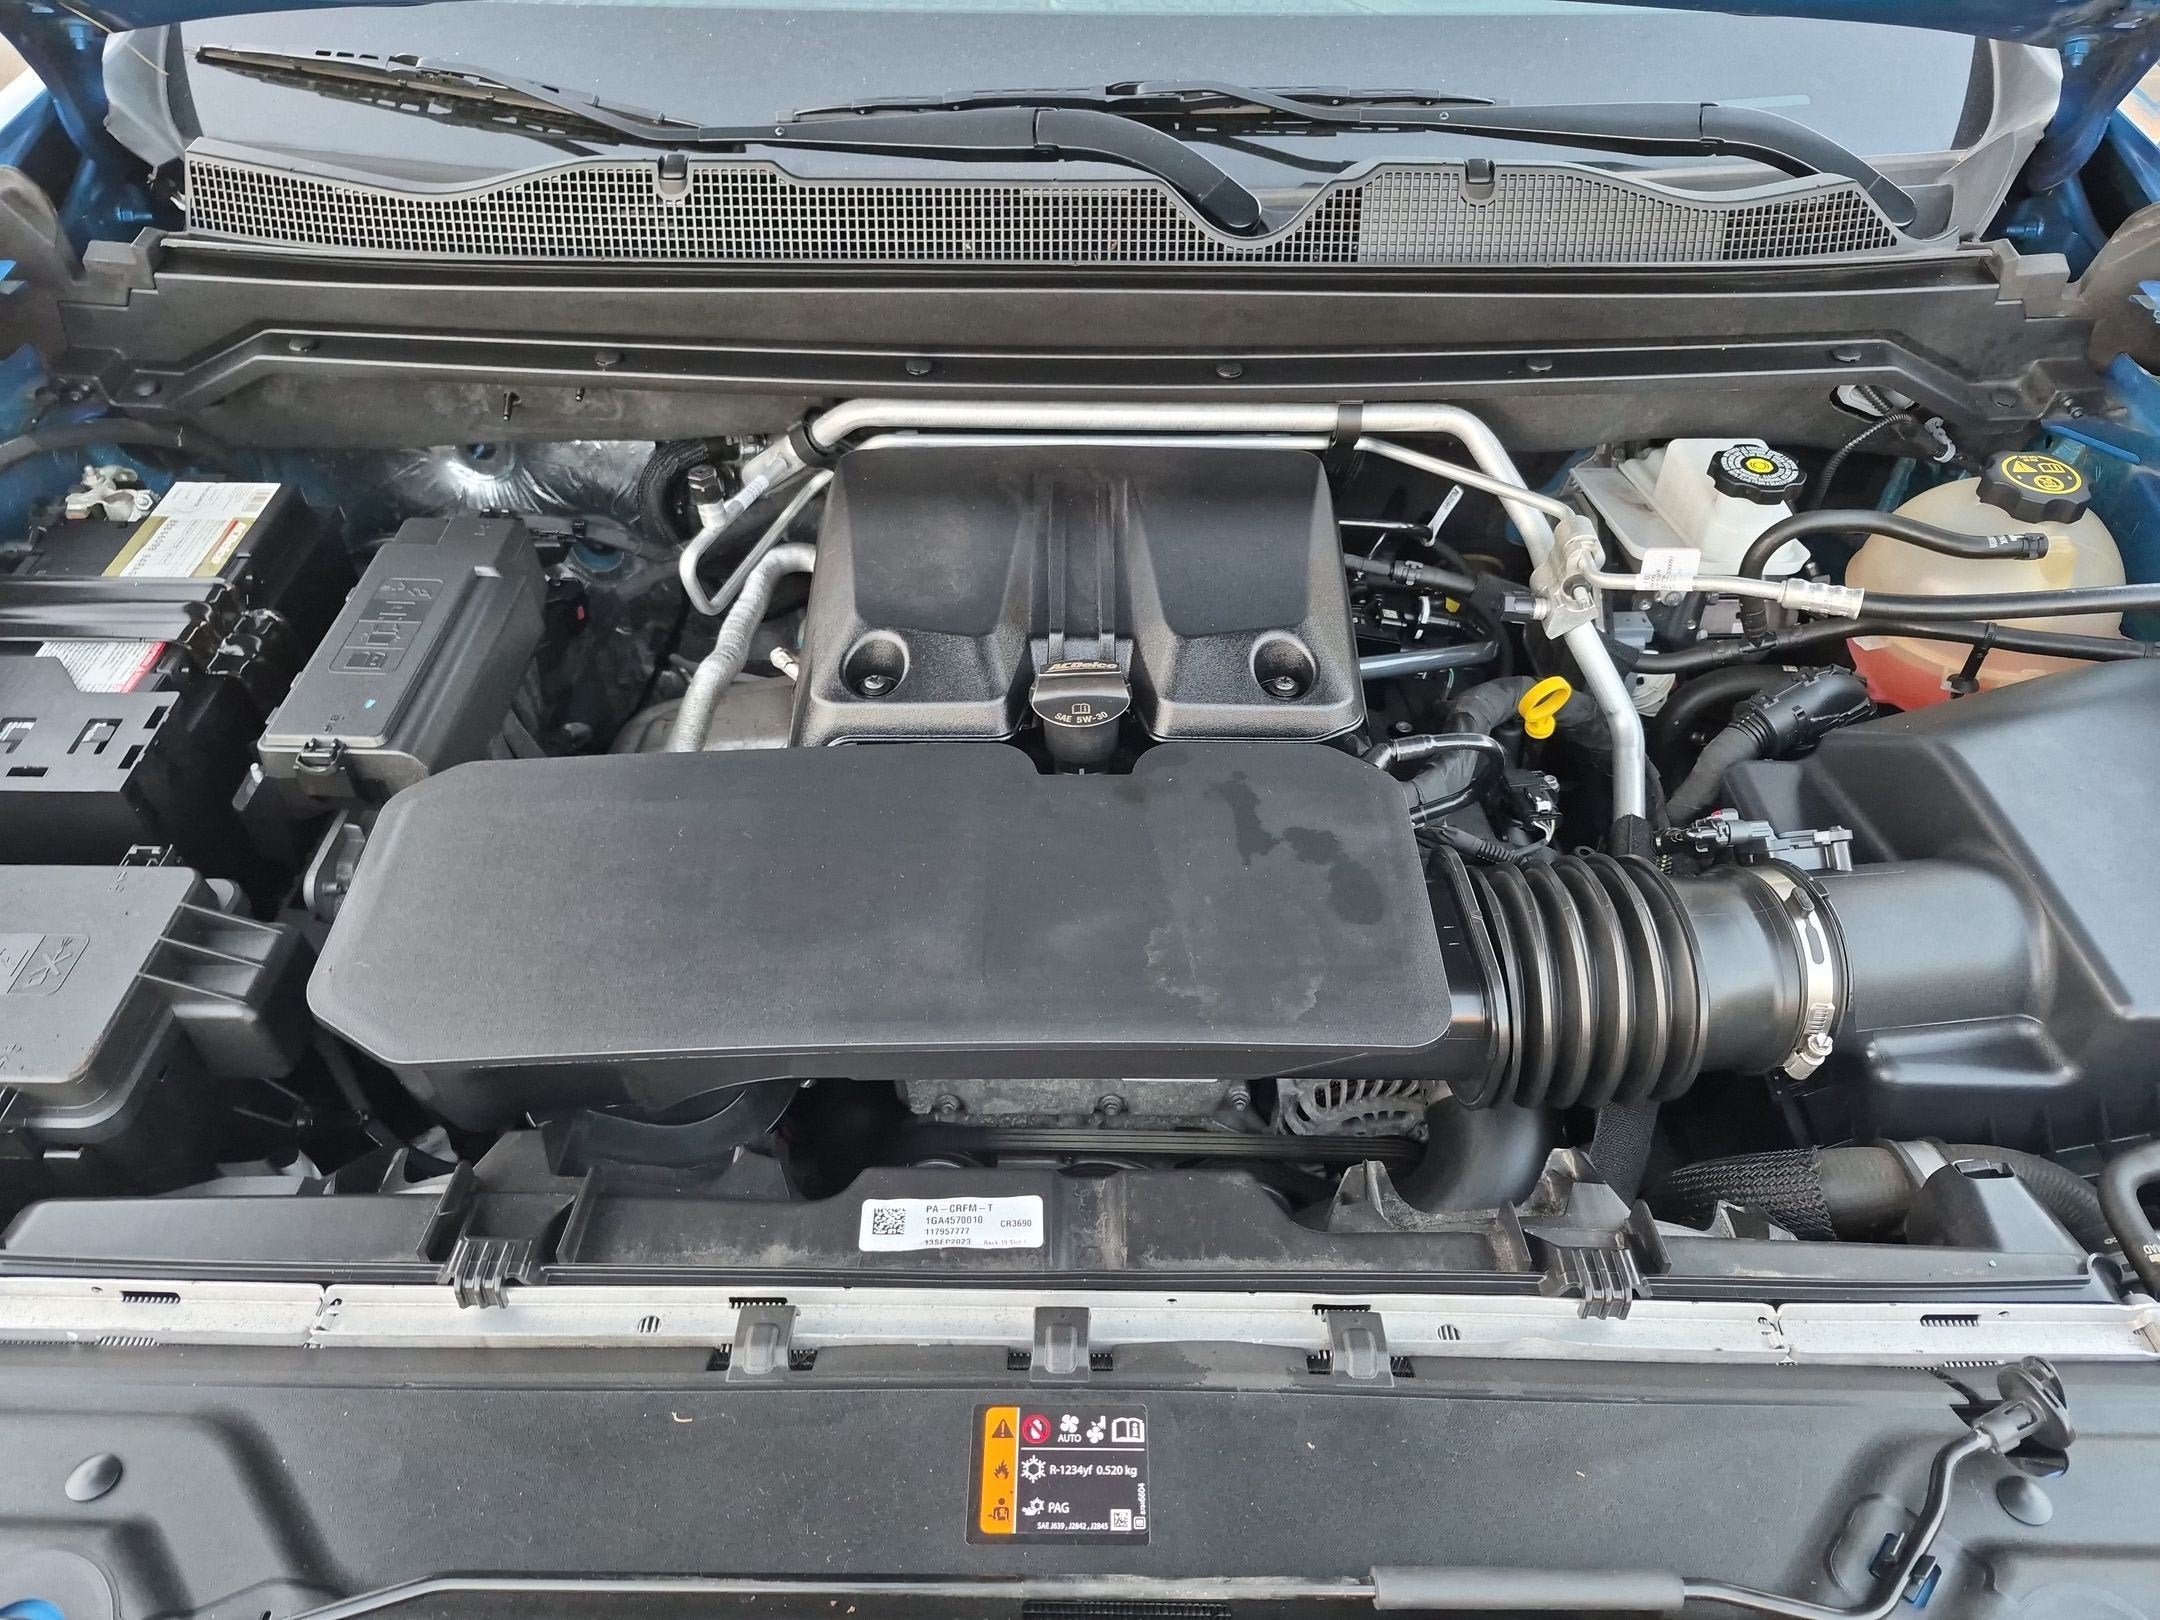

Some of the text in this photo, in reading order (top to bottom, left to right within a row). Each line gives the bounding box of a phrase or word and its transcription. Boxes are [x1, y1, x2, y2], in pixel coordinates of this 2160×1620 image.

[1048, 661, 1118, 671] ACDelco
[1055, 711, 1108, 724] SAE 5W-30
[926, 1216, 983, 1225] 1GA4570010
[1000, 1219, 1032, 1228] CR3690
[1057, 1434, 1082, 1443] AUTO
[1049, 1465, 1138, 1478] R-1234yf 0.520 kg
[1048, 1502, 1070, 1513] PAG
[1037, 1522, 1049, 1530] SAE
[1090, 1522, 1109, 1530] J2845
